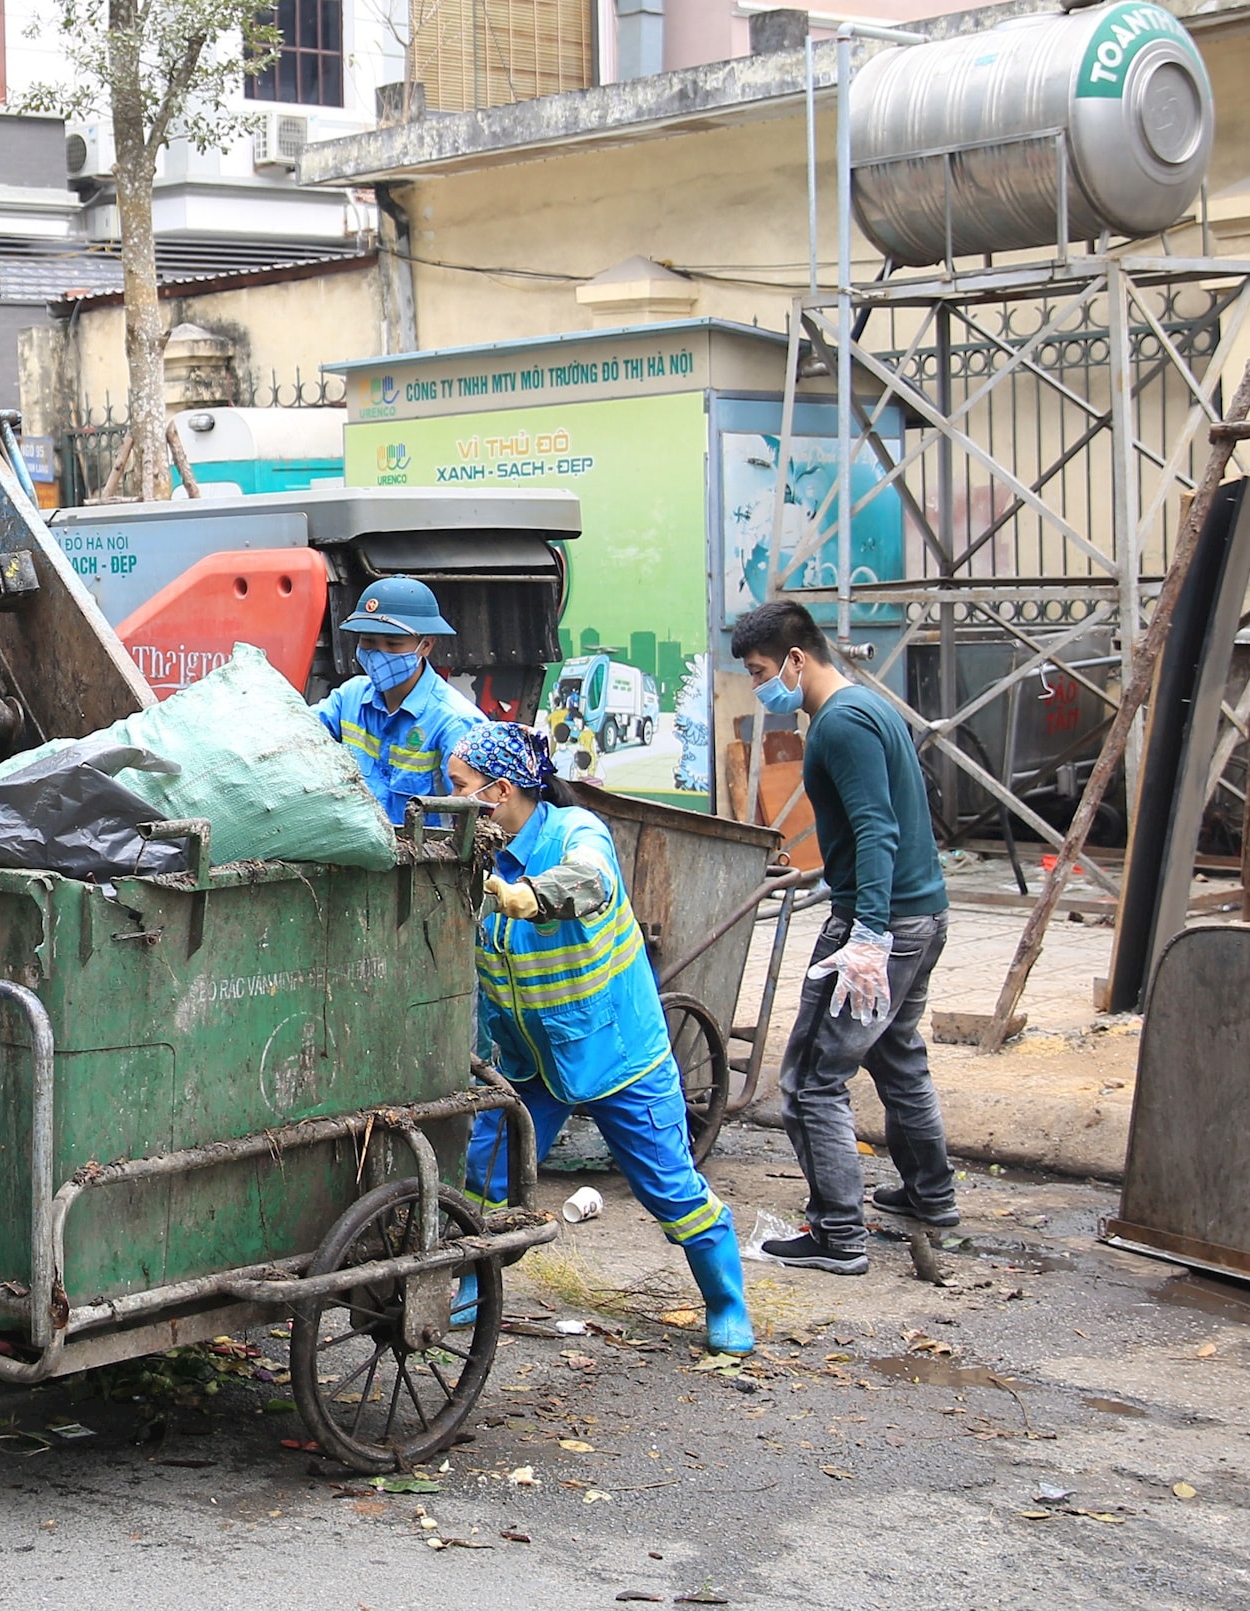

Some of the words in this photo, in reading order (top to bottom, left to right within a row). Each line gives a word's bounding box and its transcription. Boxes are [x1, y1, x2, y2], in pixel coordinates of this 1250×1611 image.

[406, 379, 437, 402] CÔNG
[441, 379, 454, 398] TY
[457, 375, 488, 397] TNHH
[492, 372, 516, 393] MTV
[521, 364, 544, 390] MÔI
[548, 360, 598, 387] TRƯỜNG
[602, 356, 619, 382] ĐÔ
[623, 358, 644, 382] THỊ
[647, 351, 665, 377] HÀ
[670, 348, 693, 378] NỘI
[359, 406, 396, 419] URENCO
[458, 436, 479, 459] VÌ
[486, 431, 529, 457] THỦ
[537, 429, 569, 453] ĐÔ
[377, 474, 407, 486] URENCO
[436, 465, 485, 482] XANH
[497, 461, 544, 480] SẠCH
[556, 457, 594, 477] ĐẸP
[65, 532, 83, 551] ĐÔ
[86, 532, 103, 551] HÀ
[107, 532, 129, 554] NỘI
[111, 555, 137, 578] ĐẸP
